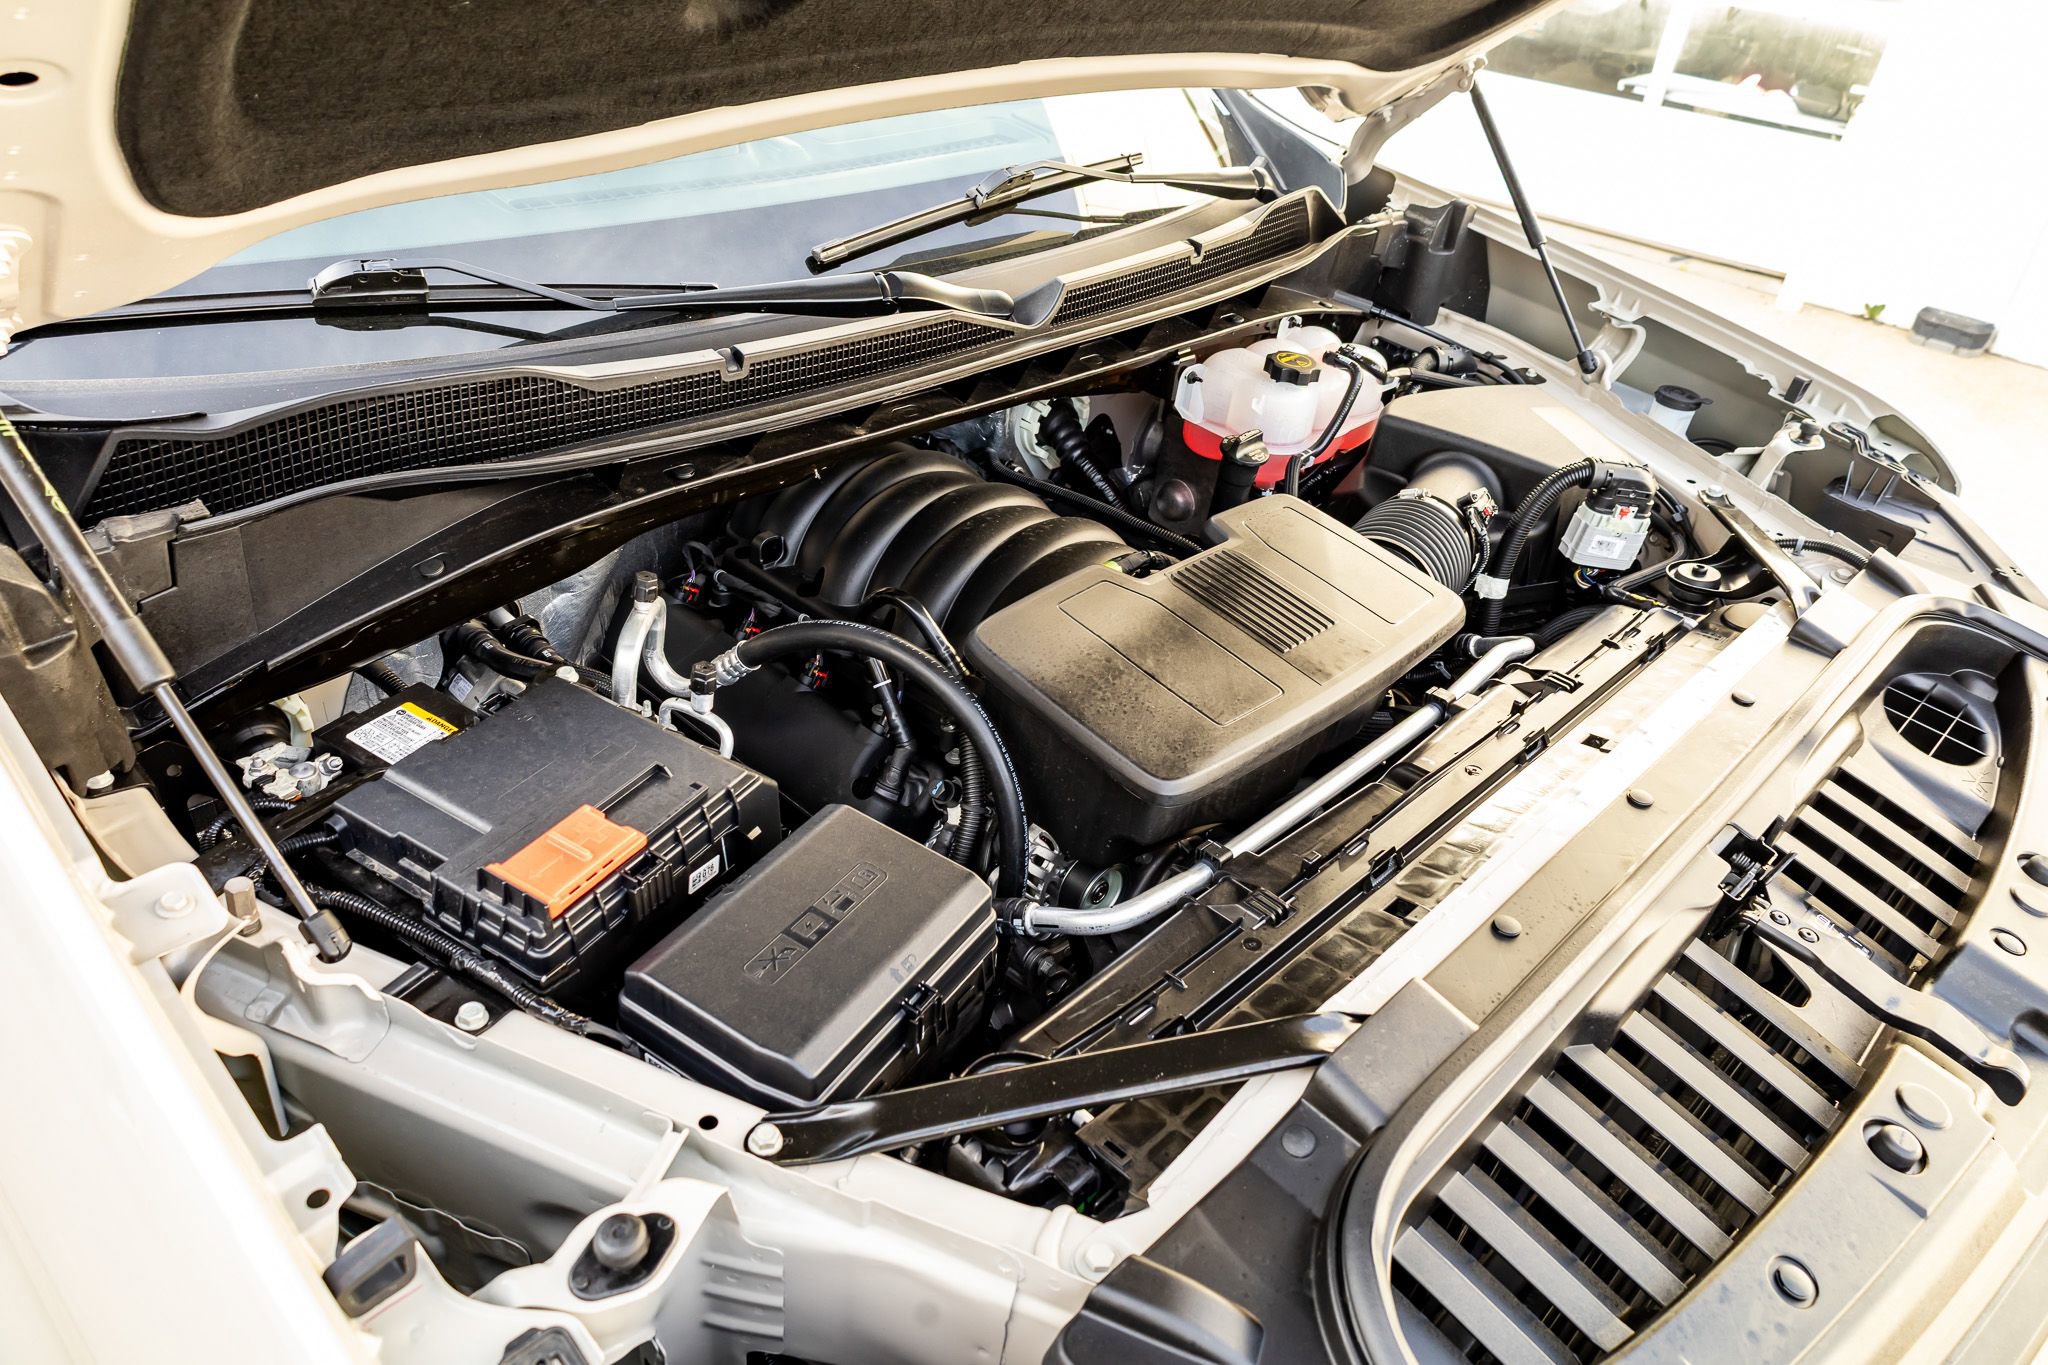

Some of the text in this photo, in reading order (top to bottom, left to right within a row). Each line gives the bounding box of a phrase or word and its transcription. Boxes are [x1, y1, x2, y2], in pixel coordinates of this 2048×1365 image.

[430, 718, 454, 732] DANGE
[1004, 753, 1014, 771] HOSE
[1012, 772, 1023, 800] SUCTION
